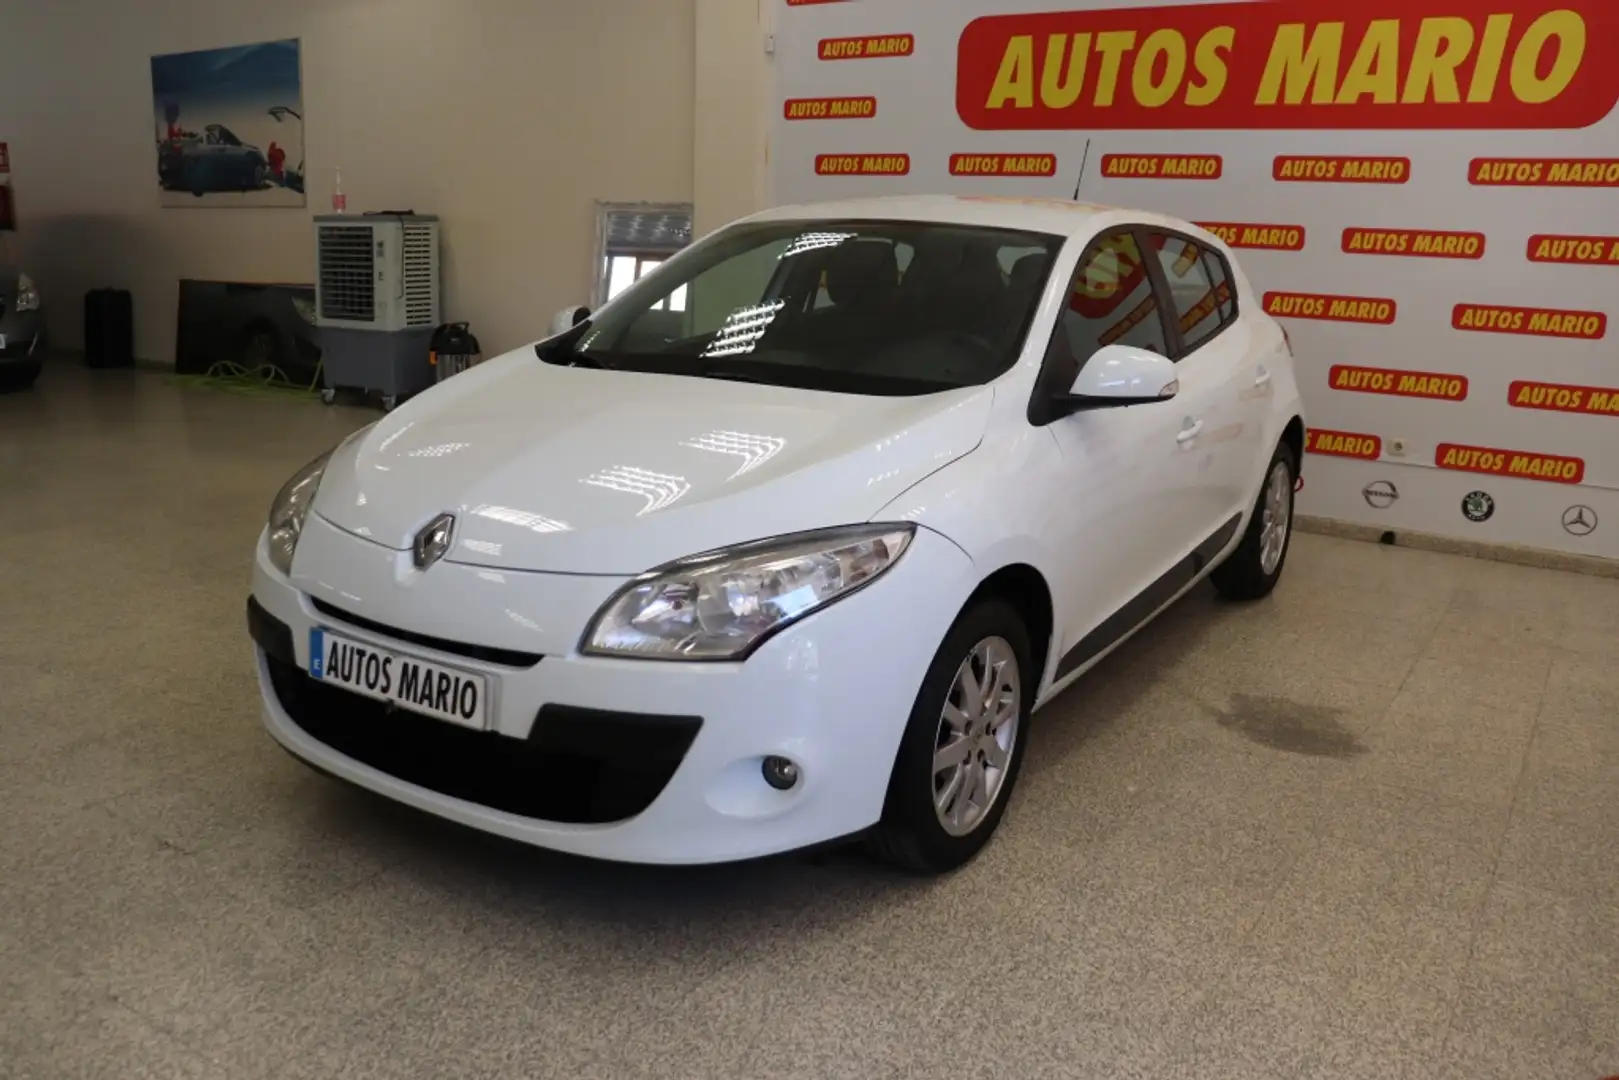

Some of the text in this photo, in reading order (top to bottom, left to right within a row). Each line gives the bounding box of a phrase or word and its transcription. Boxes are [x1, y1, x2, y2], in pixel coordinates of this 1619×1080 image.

[823, 37, 911, 57] AUTOS MARIO
[986, 9, 1587, 109] AUTOS MARIO
[789, 100, 873, 117] AUTOS MARIO
[819, 156, 906, 173] AUTOS MARIO
[954, 156, 1053, 173] AUTOS MARIO
[1106, 157, 1217, 176] AUTOS MARIO
[1281, 159, 1405, 179] AUTOS MARIO
[1476, 161, 1619, 183] AUTOS MARIO
[1241, 227, 1299, 246] MARIO
[1349, 232, 1479, 255] AUTOS MARIO
[1537, 239, 1604, 259] AUTOS
[1269, 295, 1390, 320] AUTOS MARIO
[1459, 309, 1600, 334] AUTOS MARIO
[1336, 368, 1461, 396] AUTOS MARIO
[1516, 385, 1583, 408] AUTOS
[1316, 433, 1376, 456] MARIO
[1443, 449, 1578, 479] AUTOS MARIO
[313, 659, 321, 670] E
[326, 640, 478, 720] AUTOS MARIO
